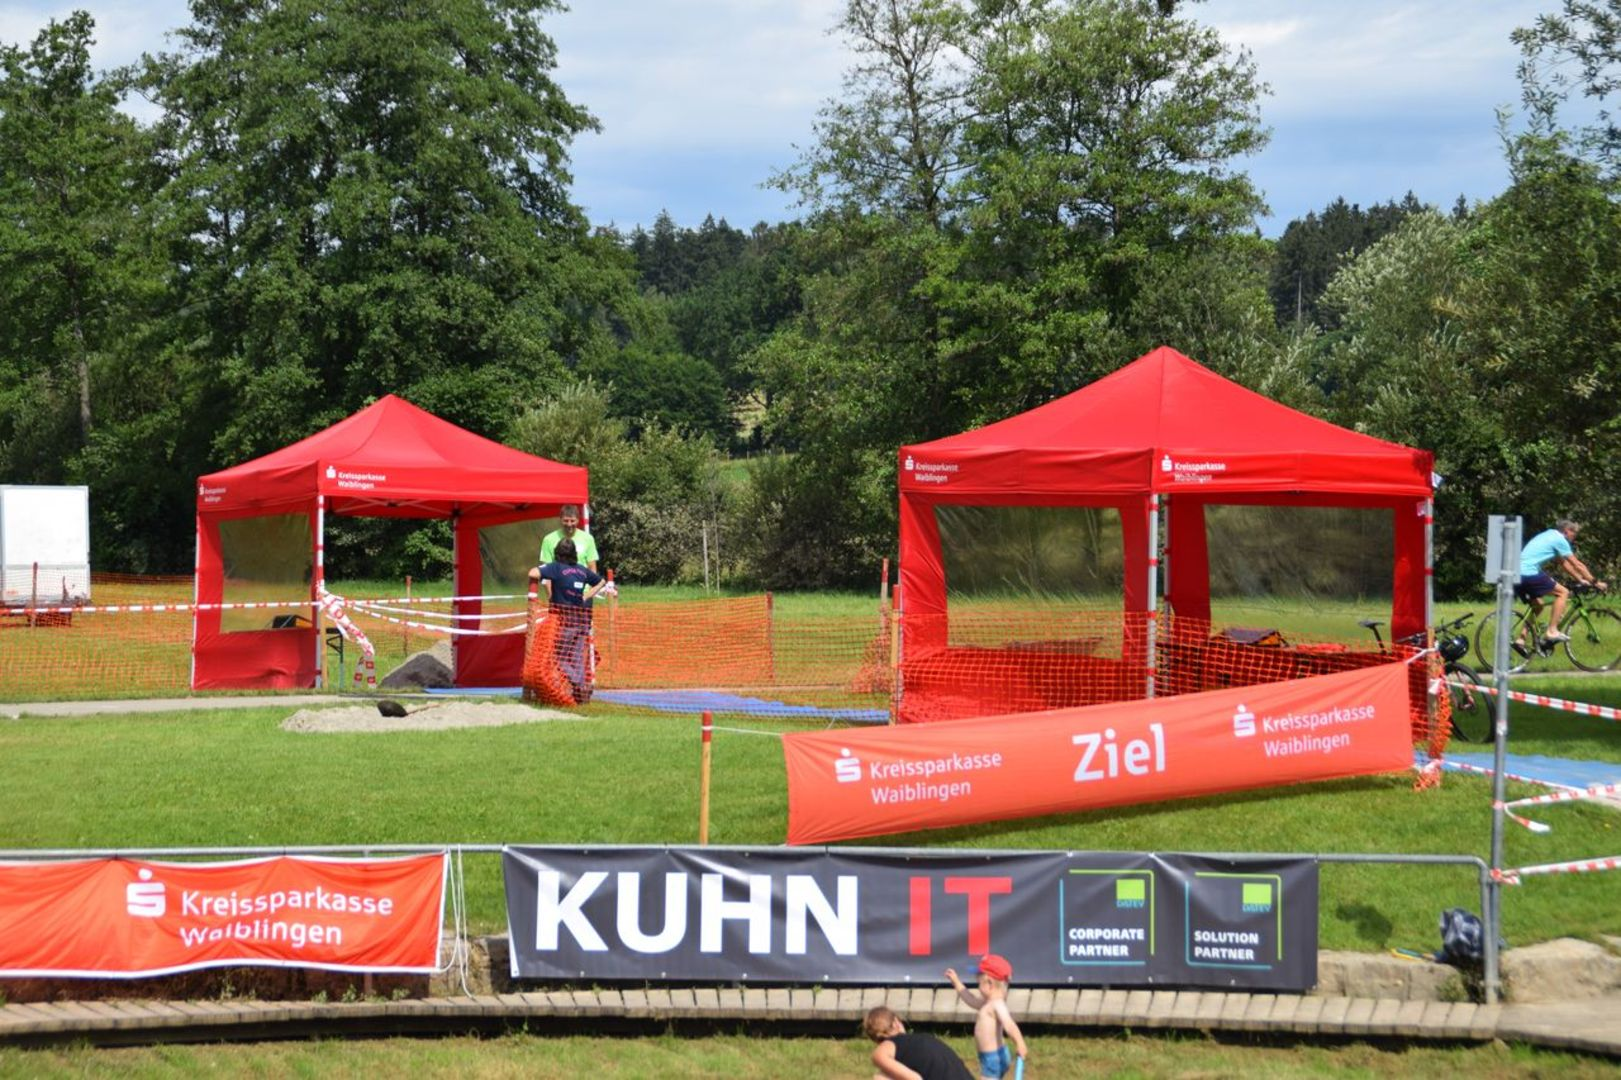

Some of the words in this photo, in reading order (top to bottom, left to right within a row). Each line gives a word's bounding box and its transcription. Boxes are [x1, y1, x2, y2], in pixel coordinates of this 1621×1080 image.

[338, 472, 386, 481] Kreissparkasse
[1174, 462, 1226, 471] Kreissparkasse
[1263, 703, 1375, 733] Kreissparkasse
[1072, 723, 1166, 782] Ziel
[1264, 731, 1350, 758] Waiblingen
[869, 751, 1003, 780] Kreissparkasse
[871, 779, 971, 805] Waiblingen
[181, 886, 393, 917] Kreissparkasse
[535, 871, 858, 955] KUHN
[909, 876, 1012, 955] IT
[180, 920, 342, 949] Waiblingen
[1069, 928, 1145, 940] CORPORATE
[1194, 930, 1259, 944] SOLUTION
[1069, 945, 1129, 957] PARTNER
[1194, 947, 1254, 960] PARTNER
